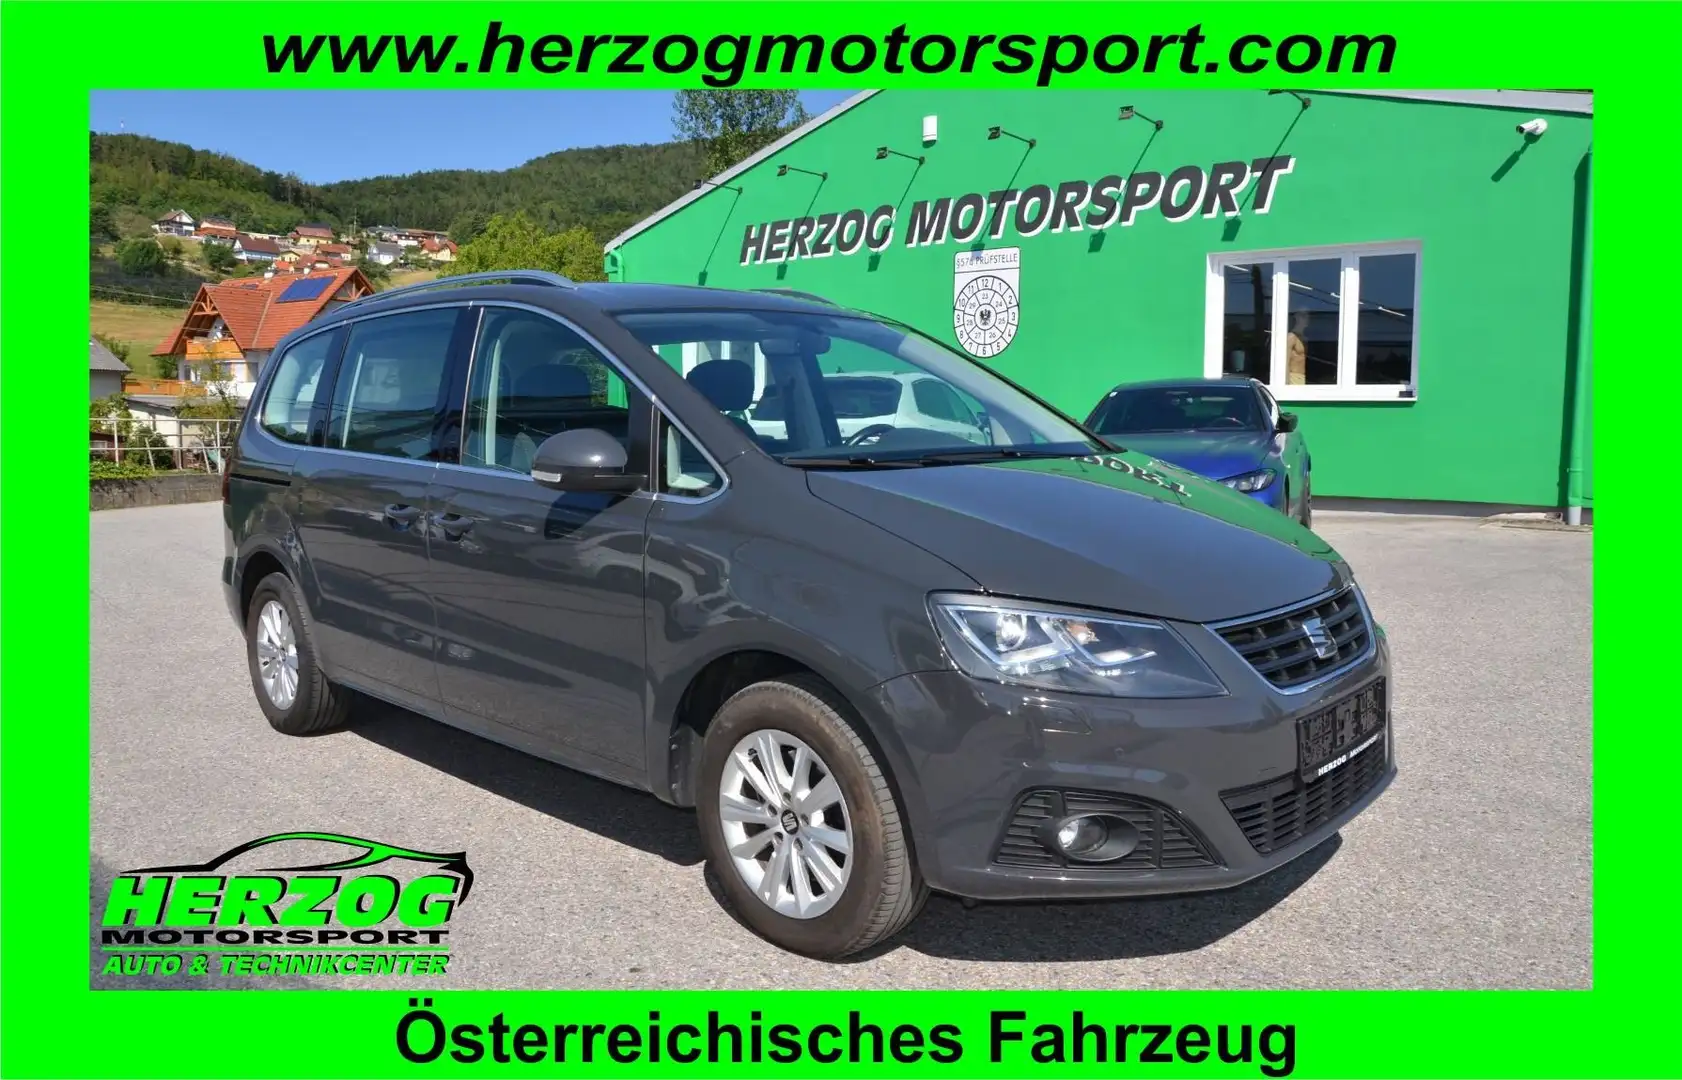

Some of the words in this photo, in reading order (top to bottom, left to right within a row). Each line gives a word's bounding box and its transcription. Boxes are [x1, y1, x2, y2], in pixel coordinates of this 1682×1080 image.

[739, 203, 895, 266] HERZOG
[905, 154, 1295, 248] MOTORSPORT
[1318, 754, 1347, 777] HERZOG
